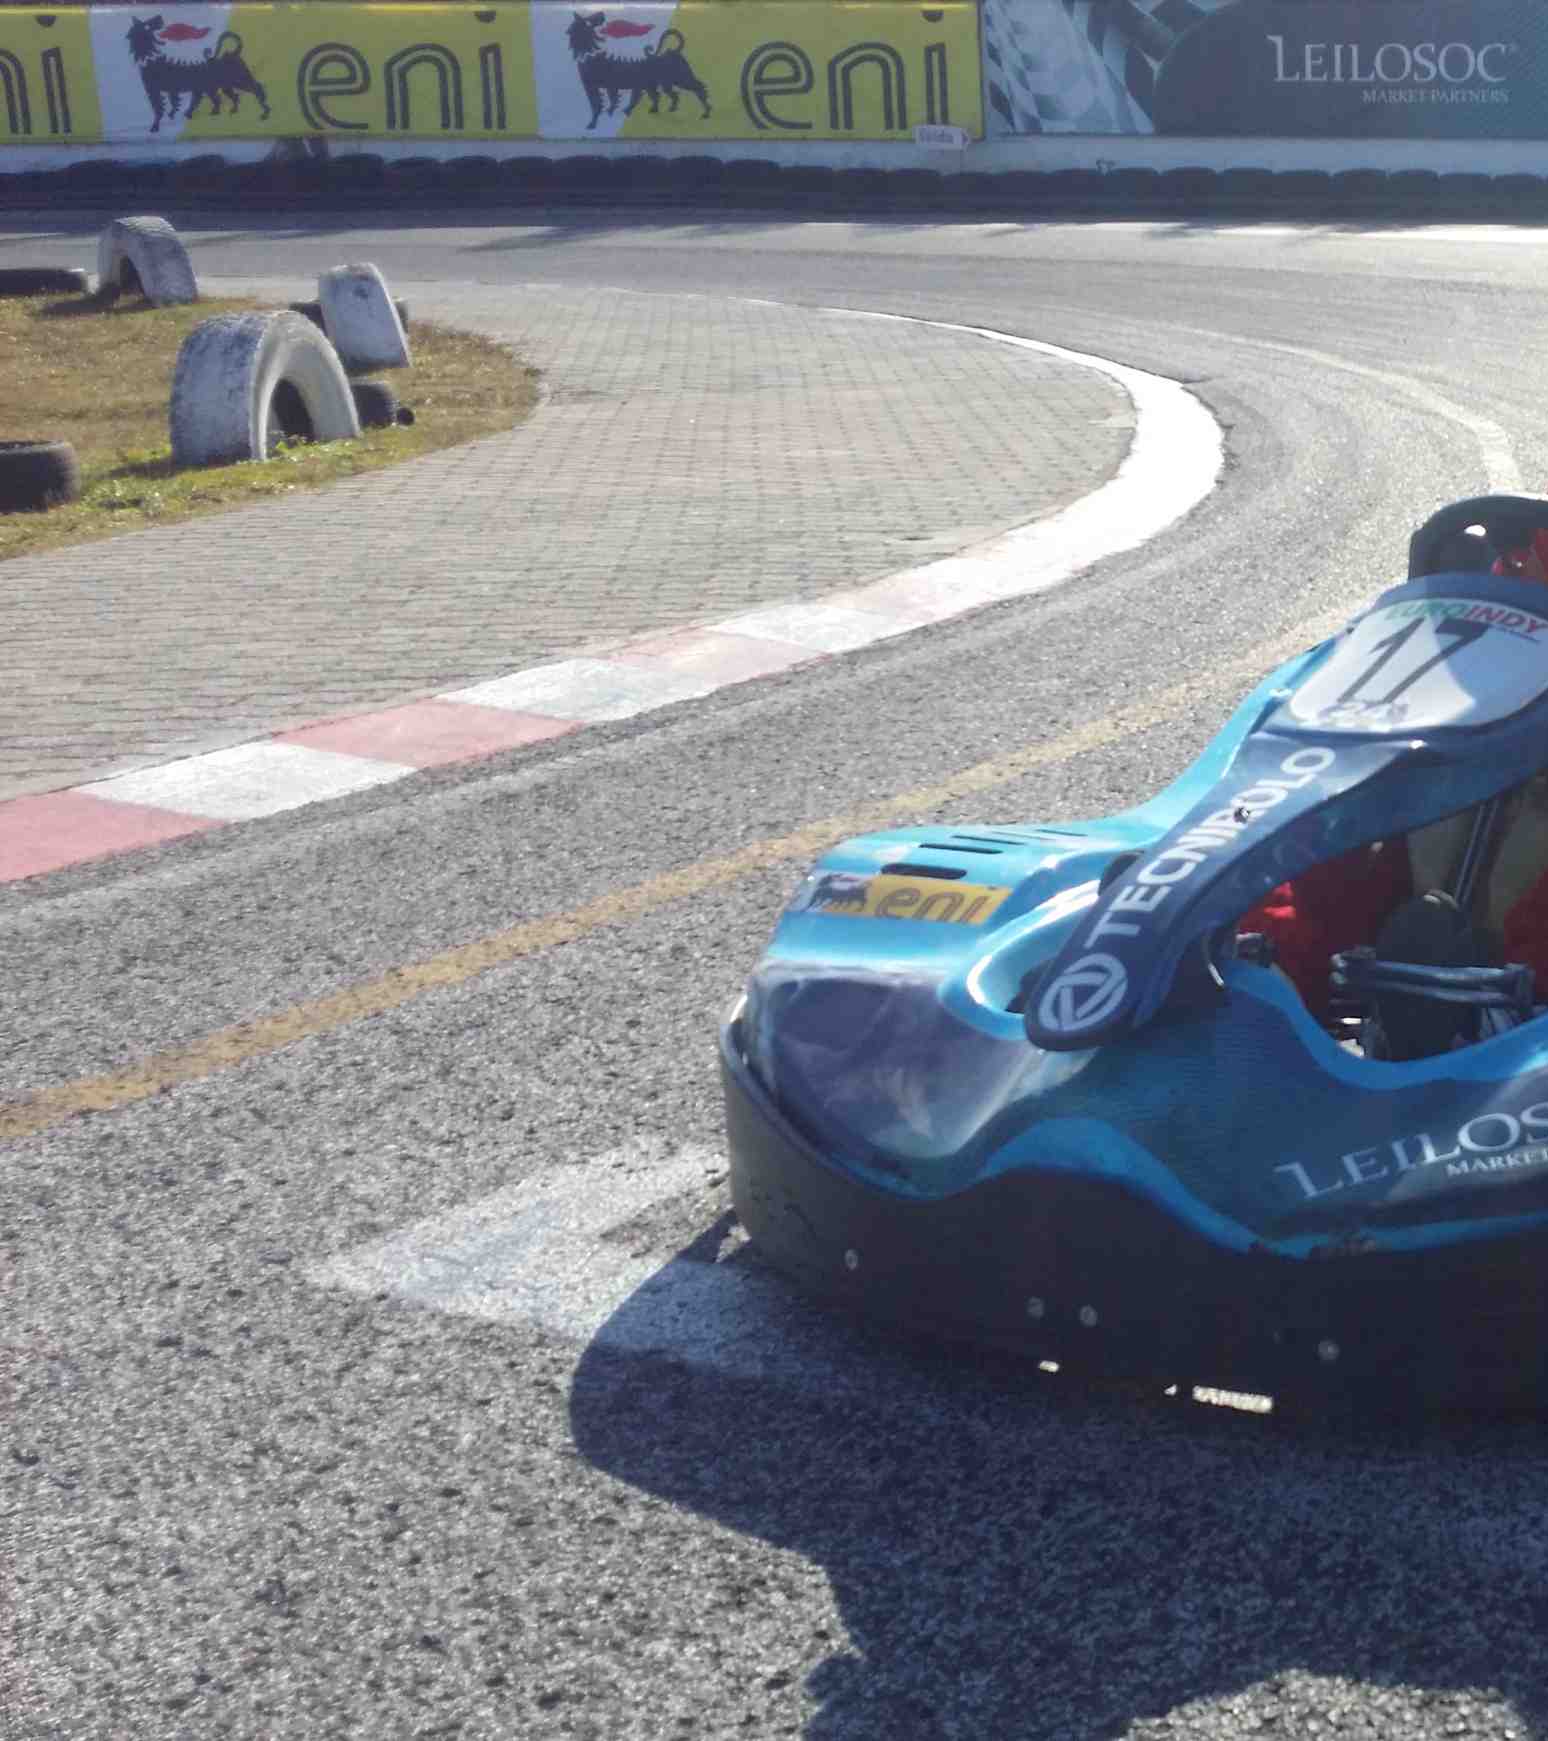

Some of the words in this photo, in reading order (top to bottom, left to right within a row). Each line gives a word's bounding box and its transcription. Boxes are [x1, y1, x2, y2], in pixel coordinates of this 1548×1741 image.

[295, 11, 506, 130] eni
[741, 11, 948, 130] eni
[1266, 34, 1507, 82] LEILOSOC
[1337, 616, 1490, 705] 17
[1085, 747, 1336, 949] TECNIROLO
[874, 886, 996, 924] eni
